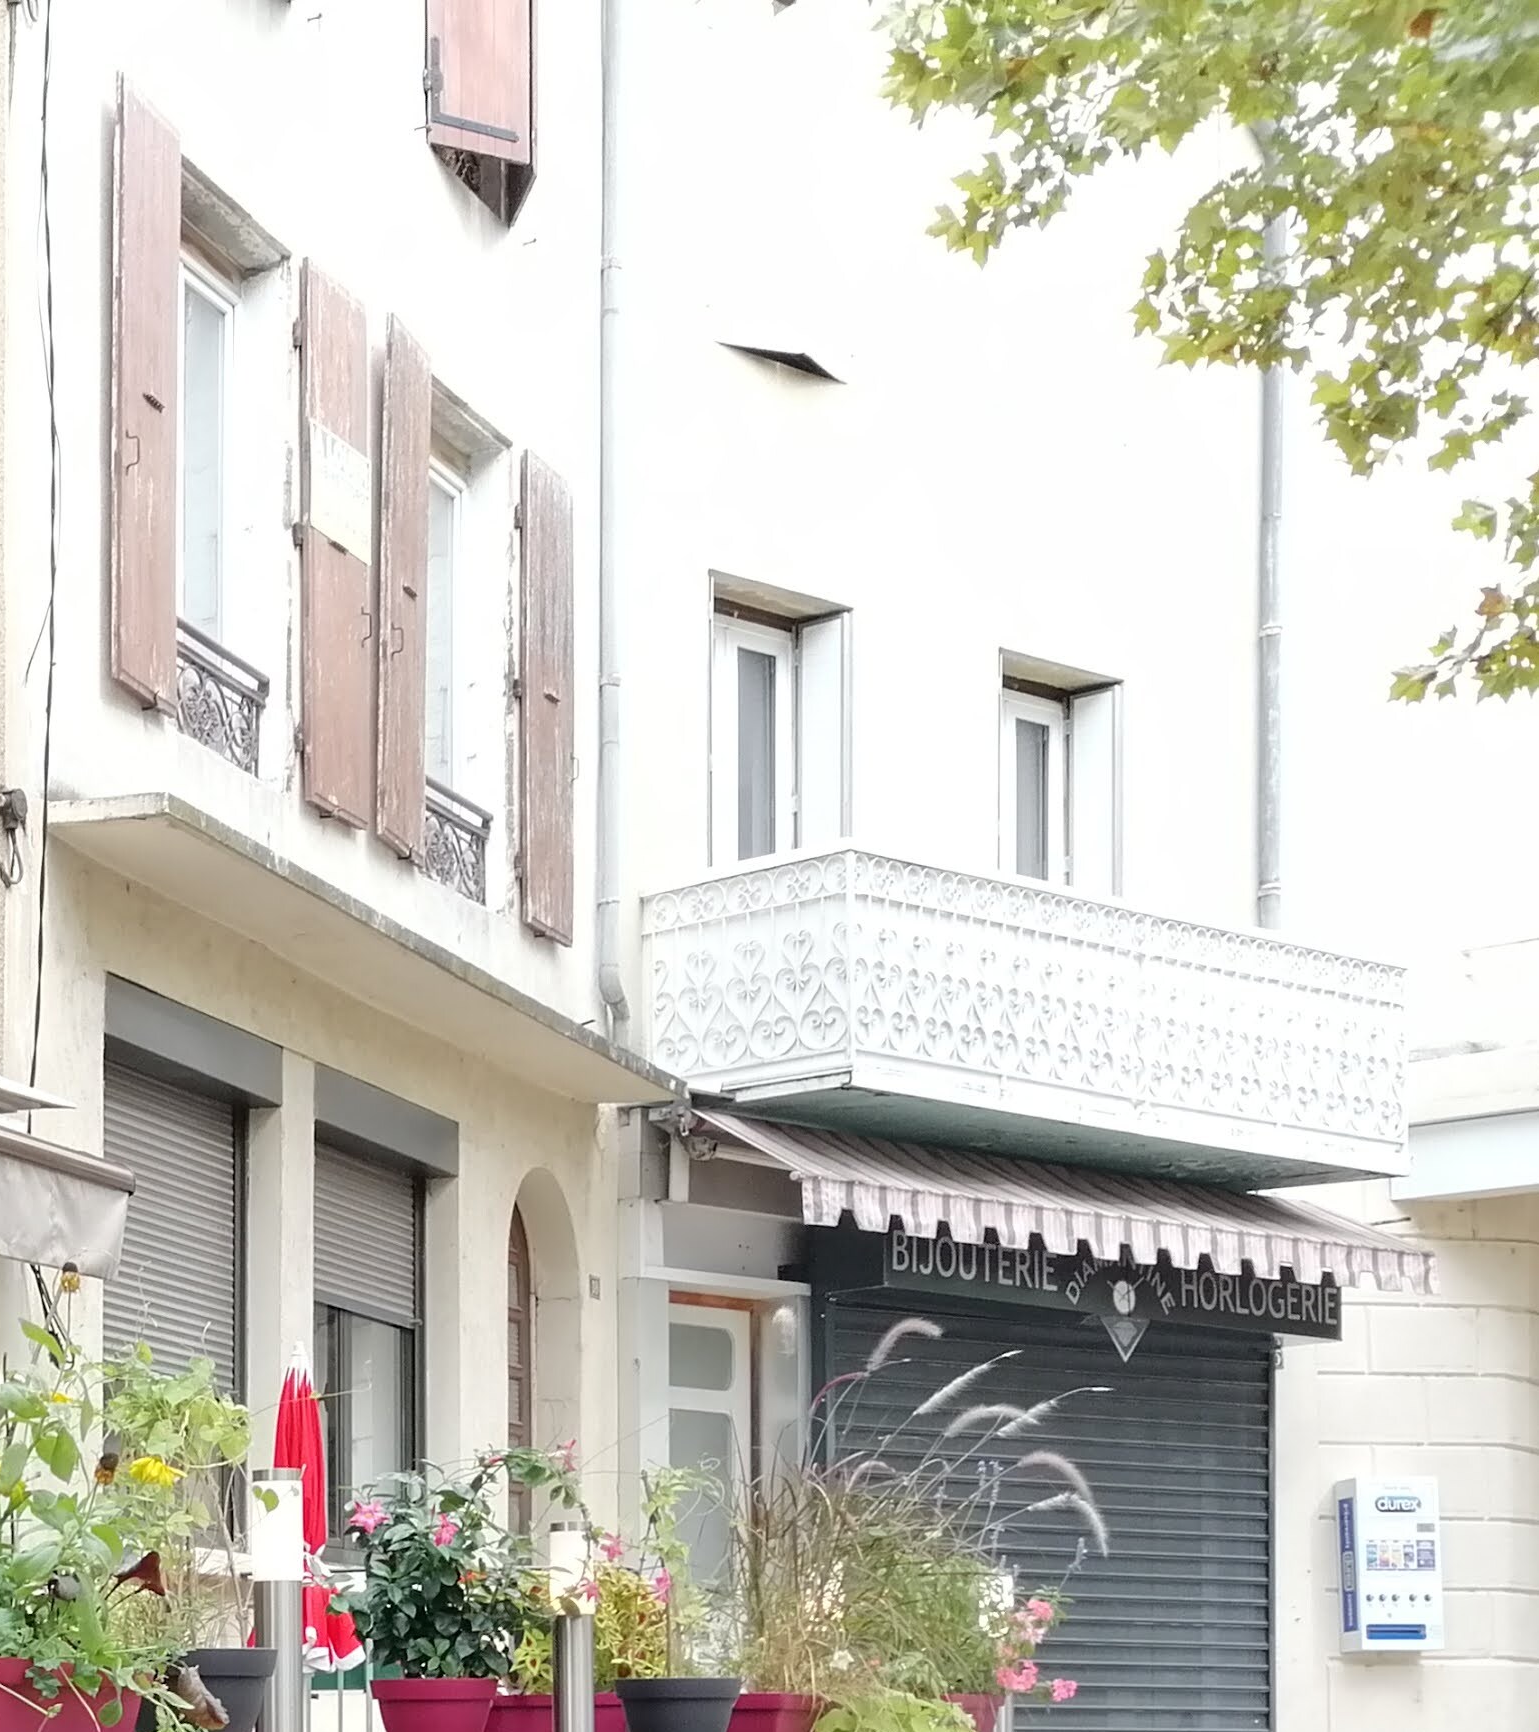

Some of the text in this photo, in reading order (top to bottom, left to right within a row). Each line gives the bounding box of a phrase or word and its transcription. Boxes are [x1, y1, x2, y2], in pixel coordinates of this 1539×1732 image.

[892, 1230, 1058, 1292] BIJOUTERIE
[1181, 1269, 1339, 1325] HORLOGERIE
[1376, 1497, 1421, 1512] durex
